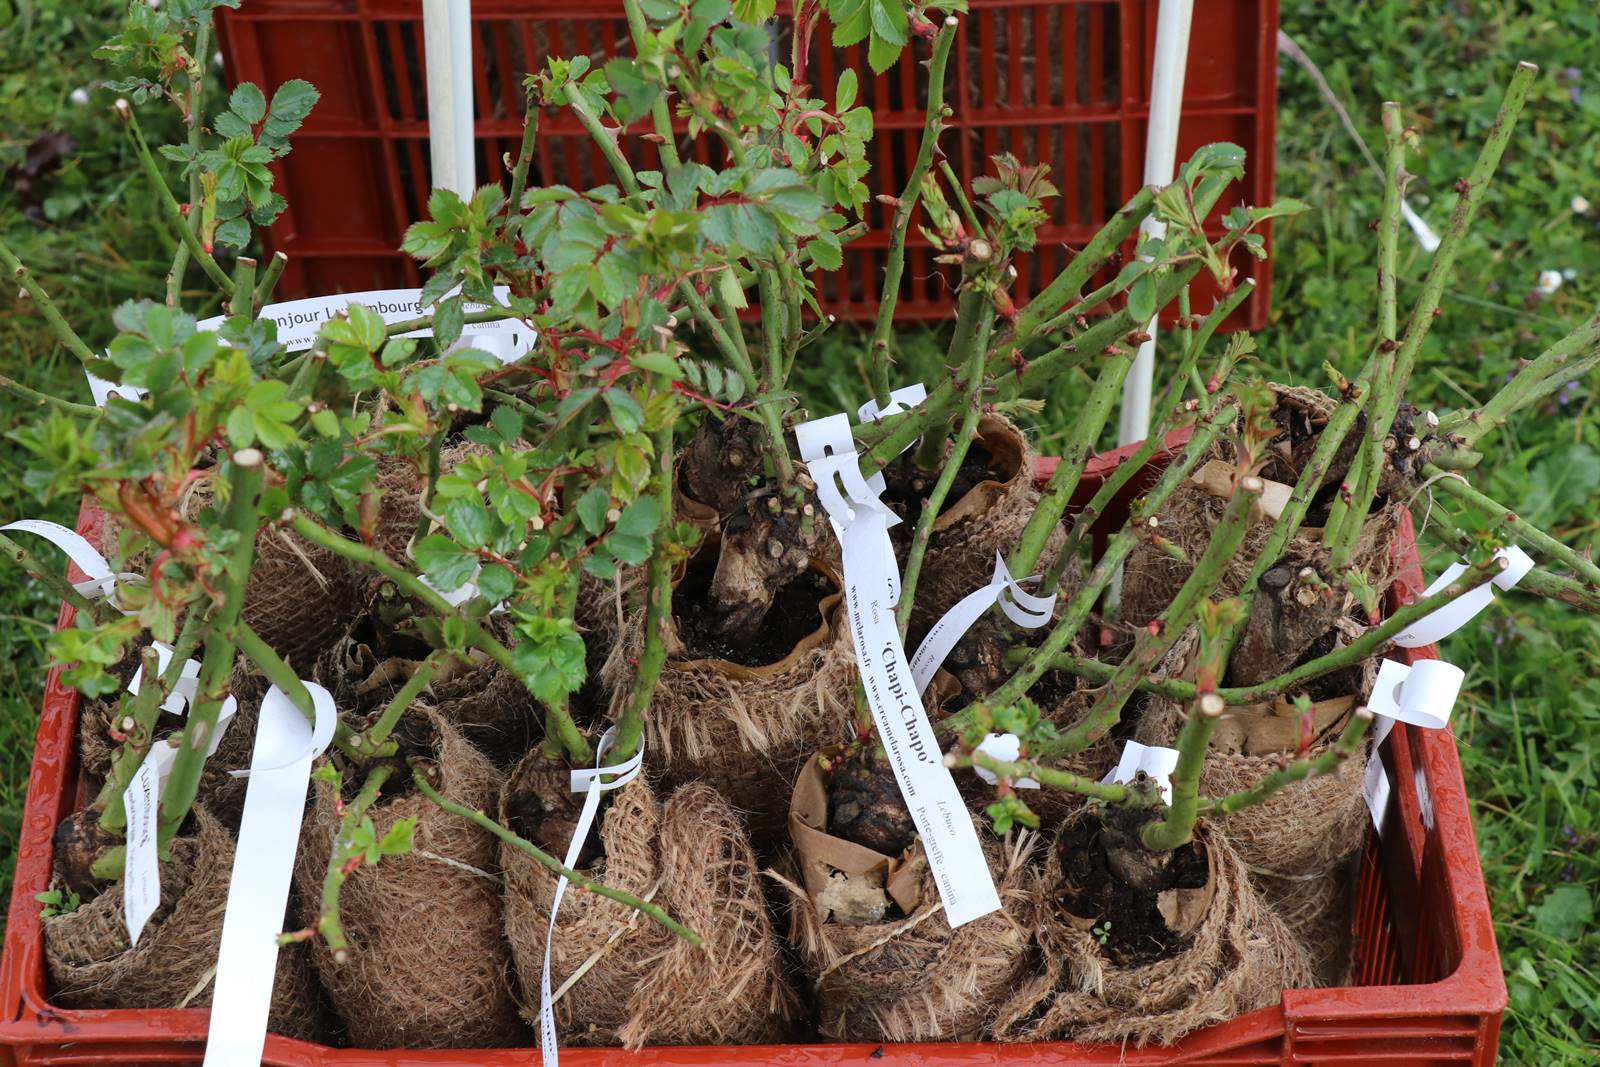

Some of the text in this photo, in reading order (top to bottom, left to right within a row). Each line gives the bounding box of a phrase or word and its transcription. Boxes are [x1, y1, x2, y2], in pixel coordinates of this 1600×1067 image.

[870, 600, 880, 625] Rosa
[850, 585, 872, 669] www.melarosa.fr
[869, 675, 917, 797] www.creamelarosa.com
[916, 806, 943, 865] Porte-greffe
[940, 873, 957, 906] canina
